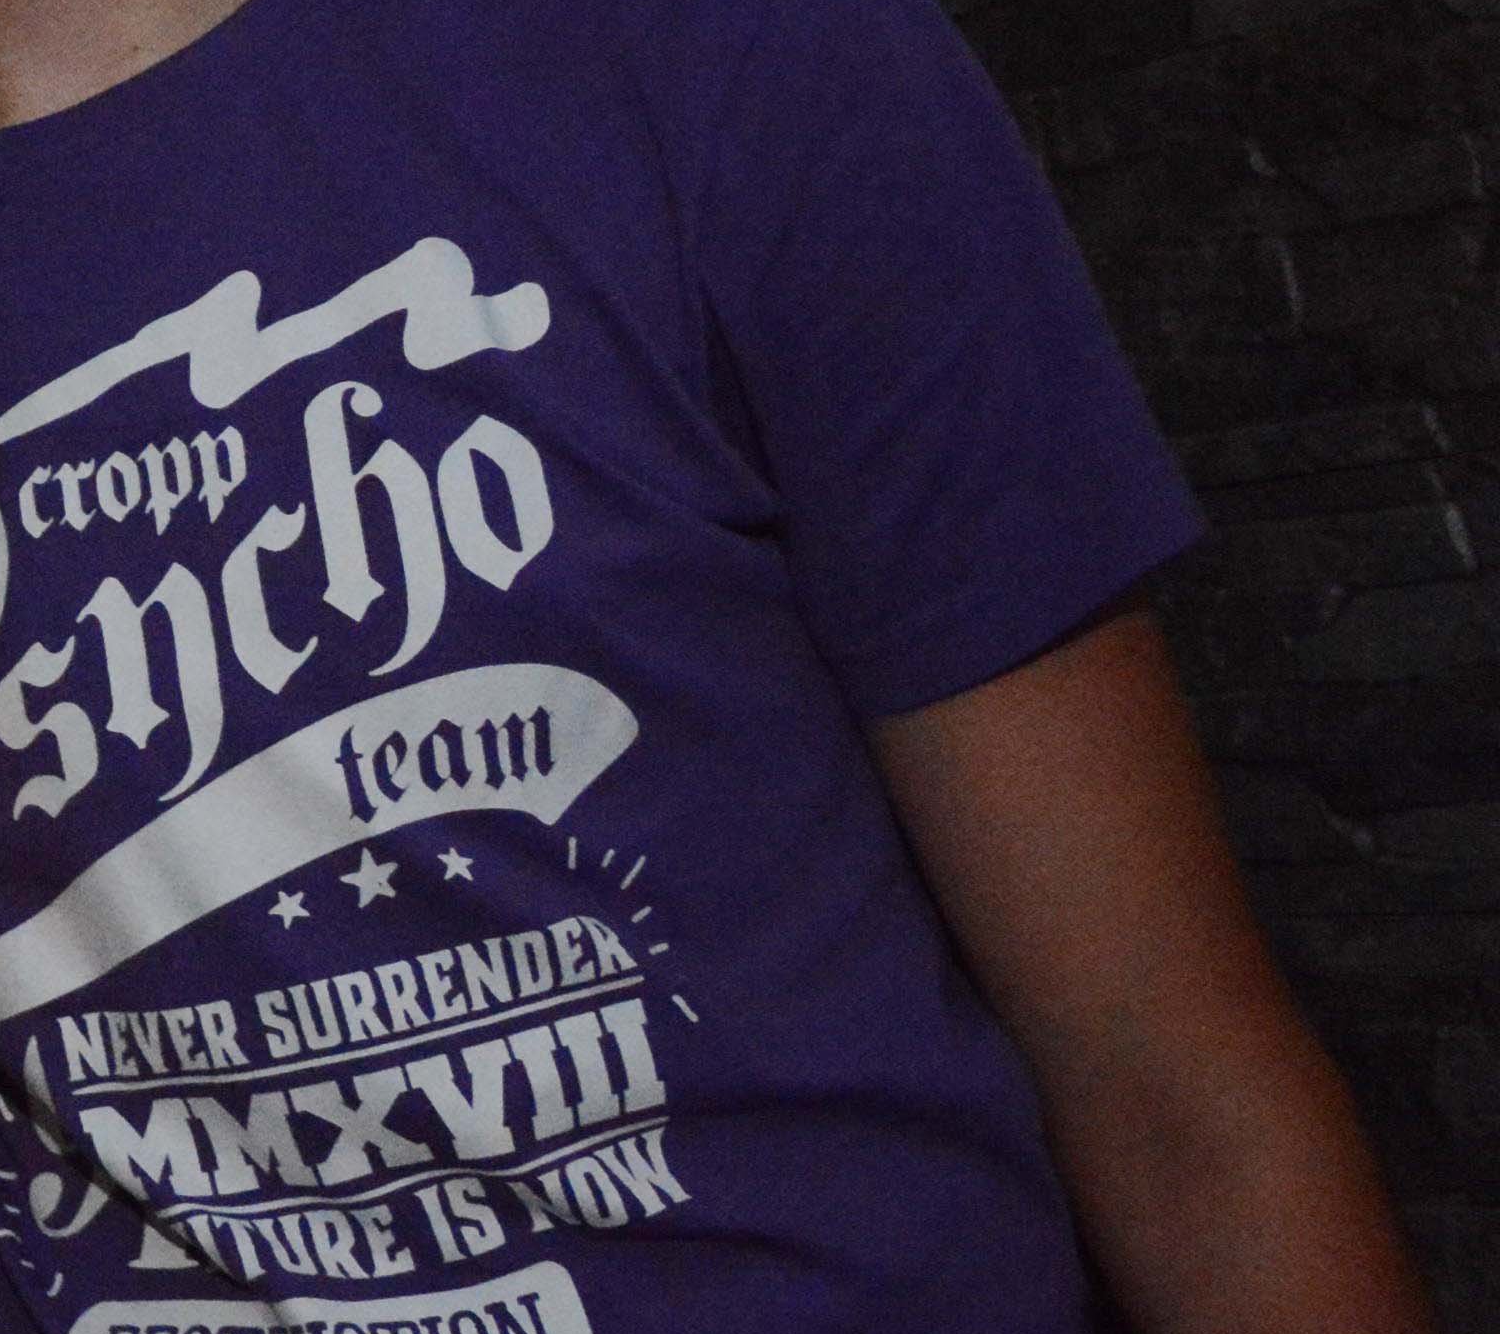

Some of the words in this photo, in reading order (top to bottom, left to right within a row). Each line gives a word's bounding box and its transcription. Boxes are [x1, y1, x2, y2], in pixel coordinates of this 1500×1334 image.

[15, 424, 249, 539] cropp
[335, 699, 557, 824] team
[57, 999, 250, 1082] NEVER
[255, 915, 638, 1053] SURRENDER
[79, 998, 669, 1198] MMXVIII
[414, 1177, 506, 1265] IS
[520, 1127, 692, 1230] NOW
